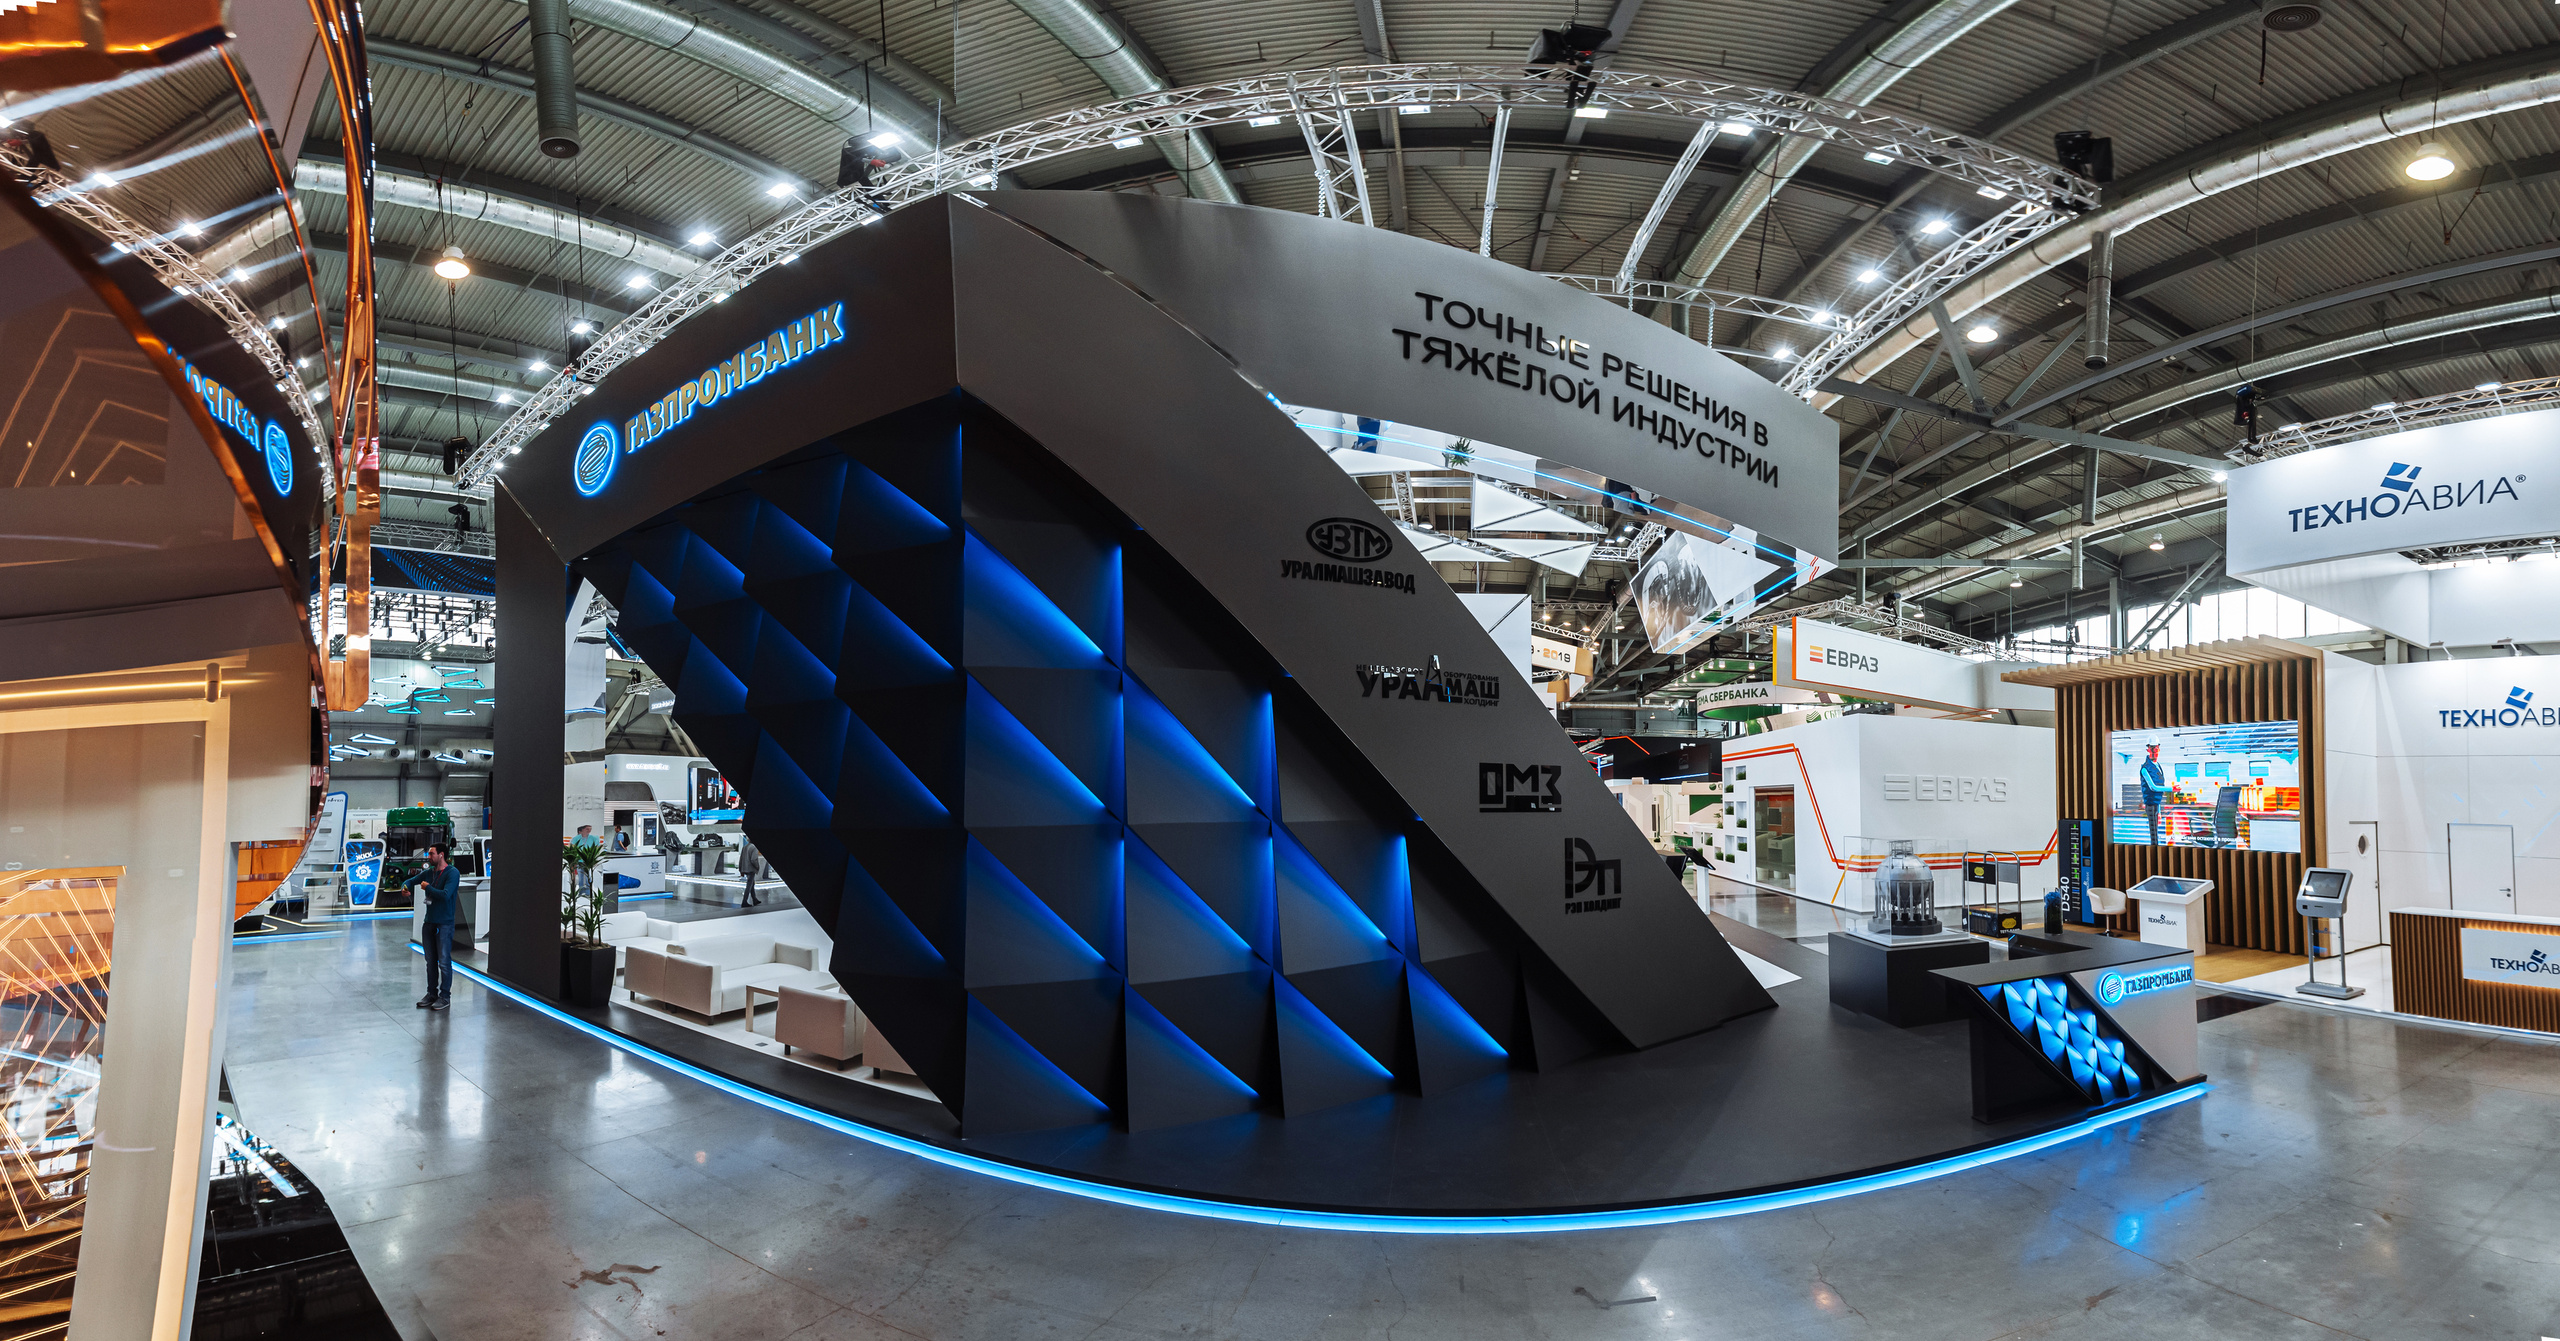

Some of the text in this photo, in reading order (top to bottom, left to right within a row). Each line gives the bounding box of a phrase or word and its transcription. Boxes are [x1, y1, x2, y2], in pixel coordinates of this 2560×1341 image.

[625, 302, 843, 453] ГАЗПРОМБАНК
[1415, 291, 1769, 447] ТОЧНЫЕ РЕШЕНИЯ В
[1392, 328, 1779, 489] ТЯЖЁЛОЙ ИНДУСТРИИ
[1315, 524, 1386, 557] УЗТМ
[1281, 560, 1416, 594] УРАЛМАШЗАВОД
[1543, 647, 1571, 663] 2019
[1826, 648, 1879, 673] ЕВРАЗ
[1443, 671, 1500, 683] ОБОРУДОВАНИЕ
[1463, 697, 1500, 707] ХОЛДИНГ
[1709, 687, 1769, 703] СБЕРБАНКА
[1915, 774, 2009, 802] ЕВРАЗ
[1565, 897, 1622, 914] РЭП ХОЛДИНГ
[2060, 876, 2070, 911] D540
[2125, 968, 2193, 994] ГАЗПРОМБАНК
